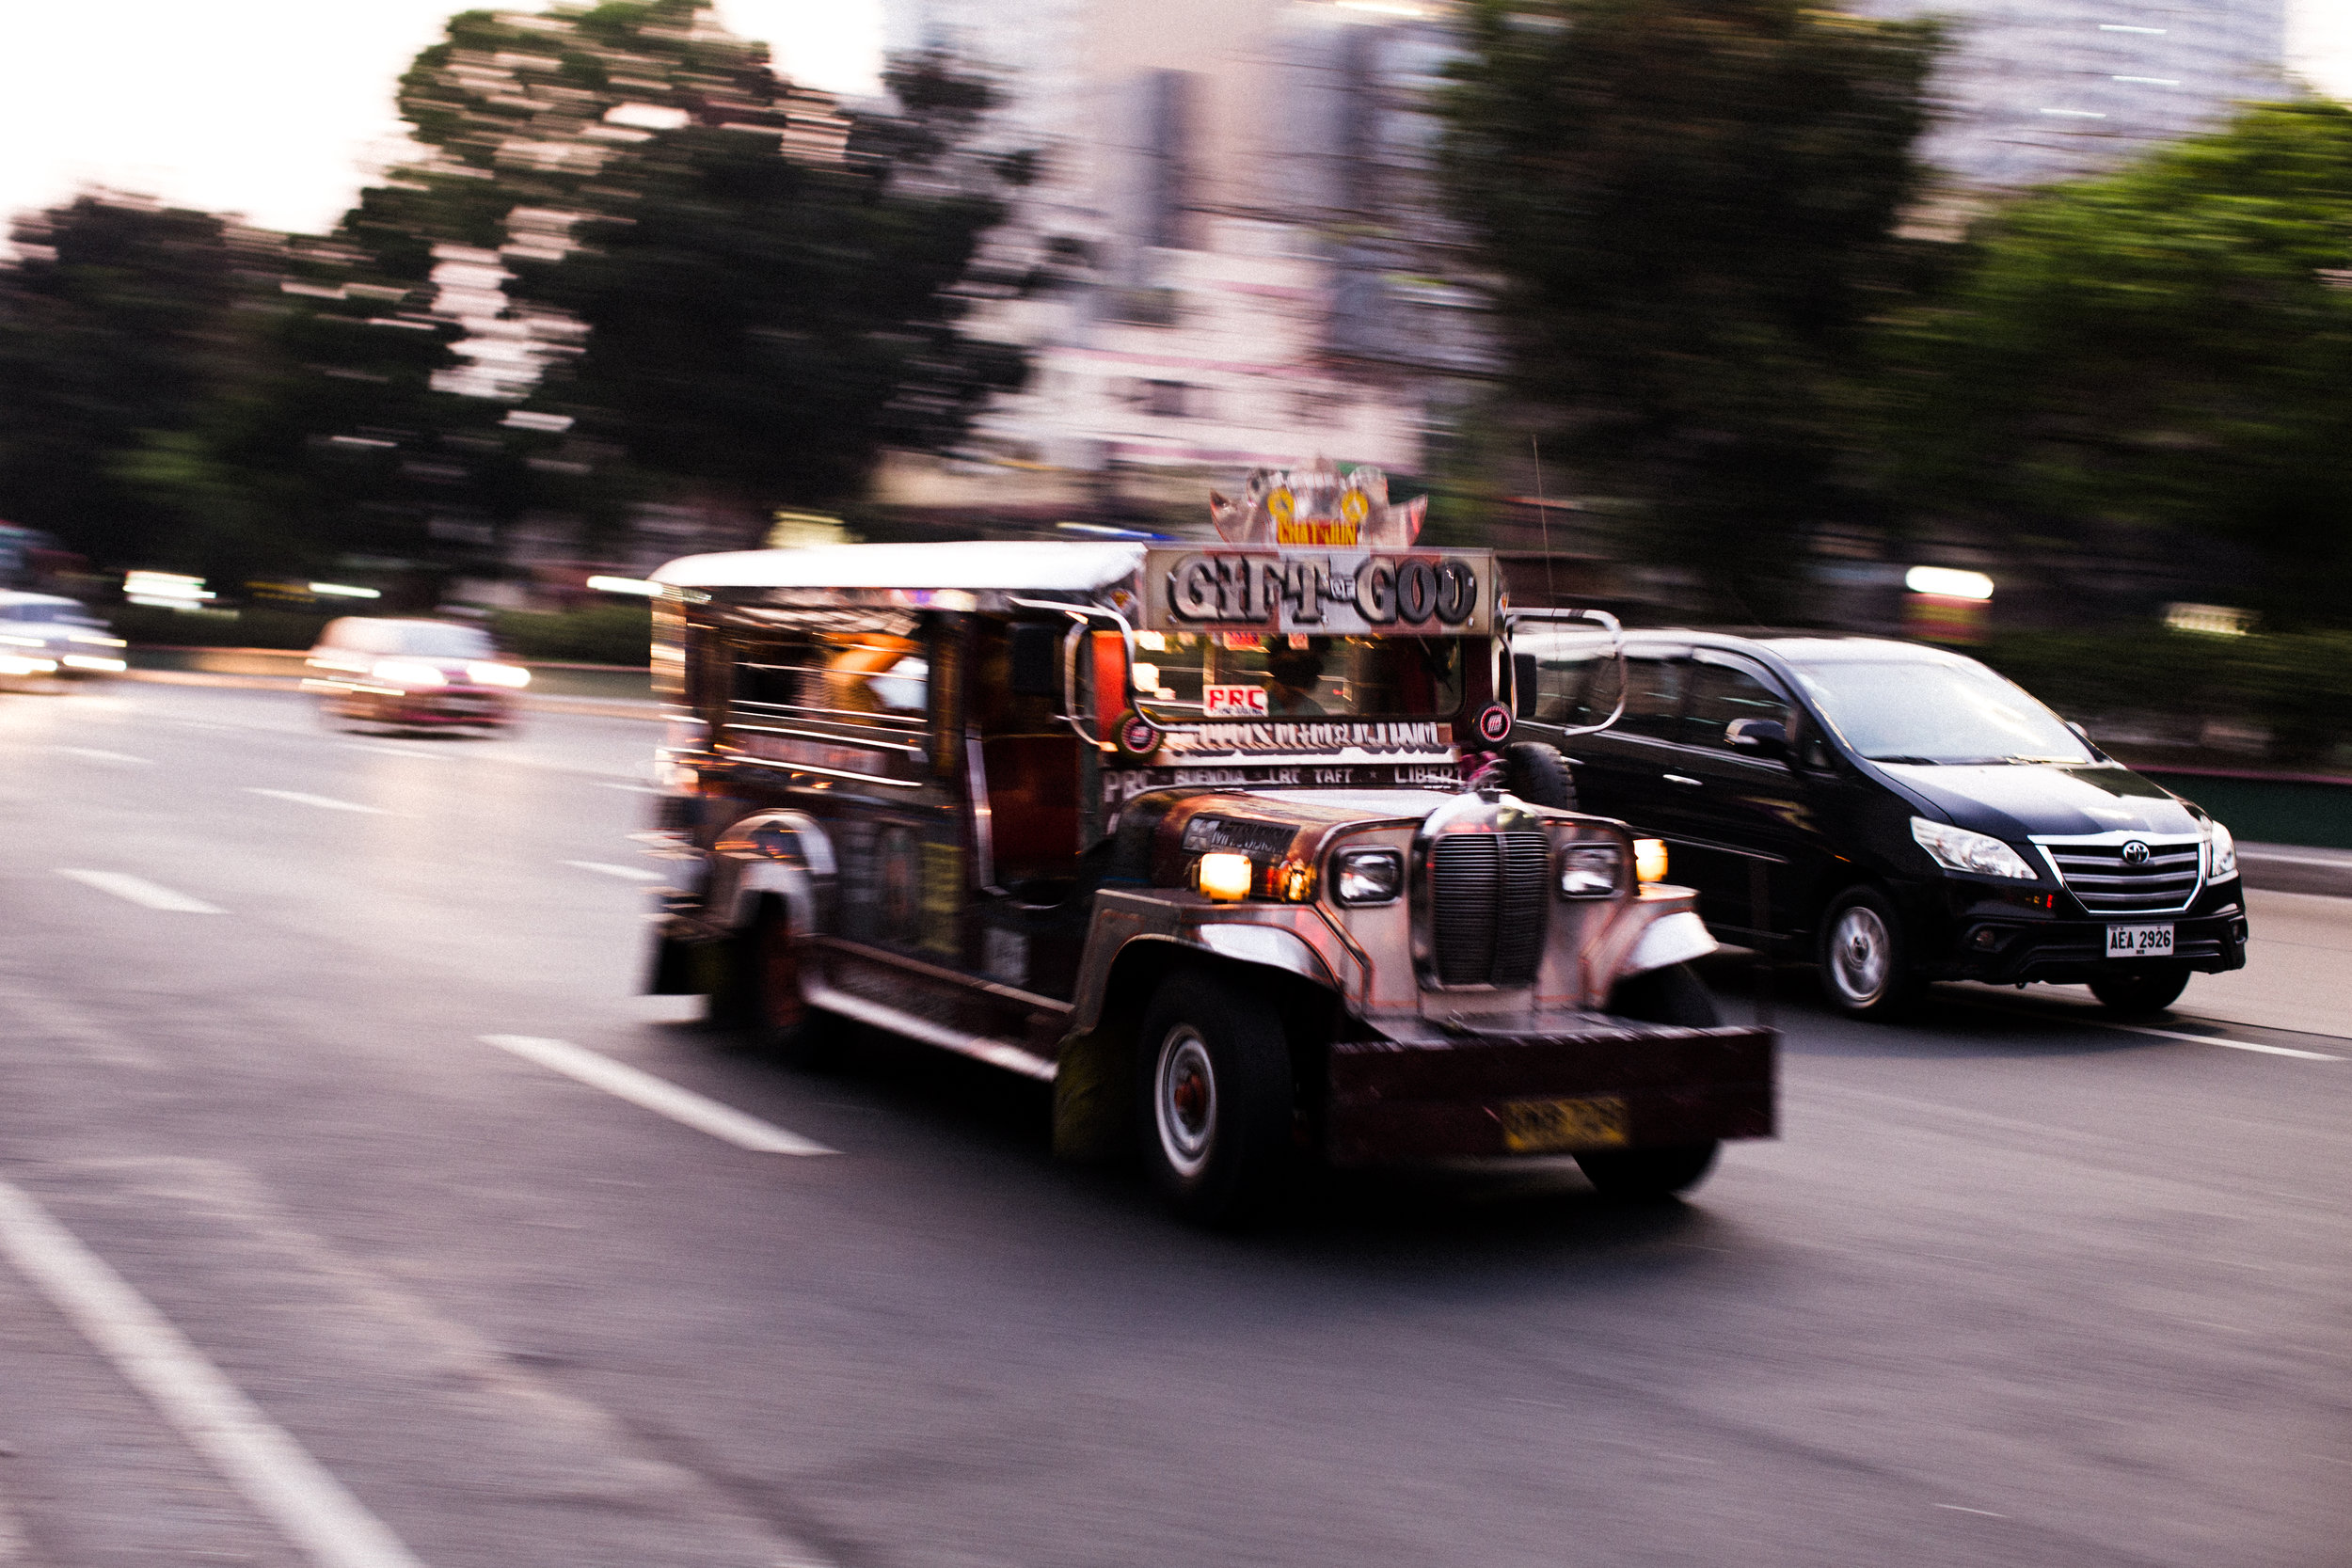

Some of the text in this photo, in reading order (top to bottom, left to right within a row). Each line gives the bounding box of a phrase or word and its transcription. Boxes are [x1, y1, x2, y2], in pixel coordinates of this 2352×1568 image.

[1168, 553, 1478, 625] GIFT OF GOD
[1210, 689, 1264, 710] PRC
[1313, 768, 1354, 784] TAFT
[2110, 929, 2171, 949] AEA 2926
